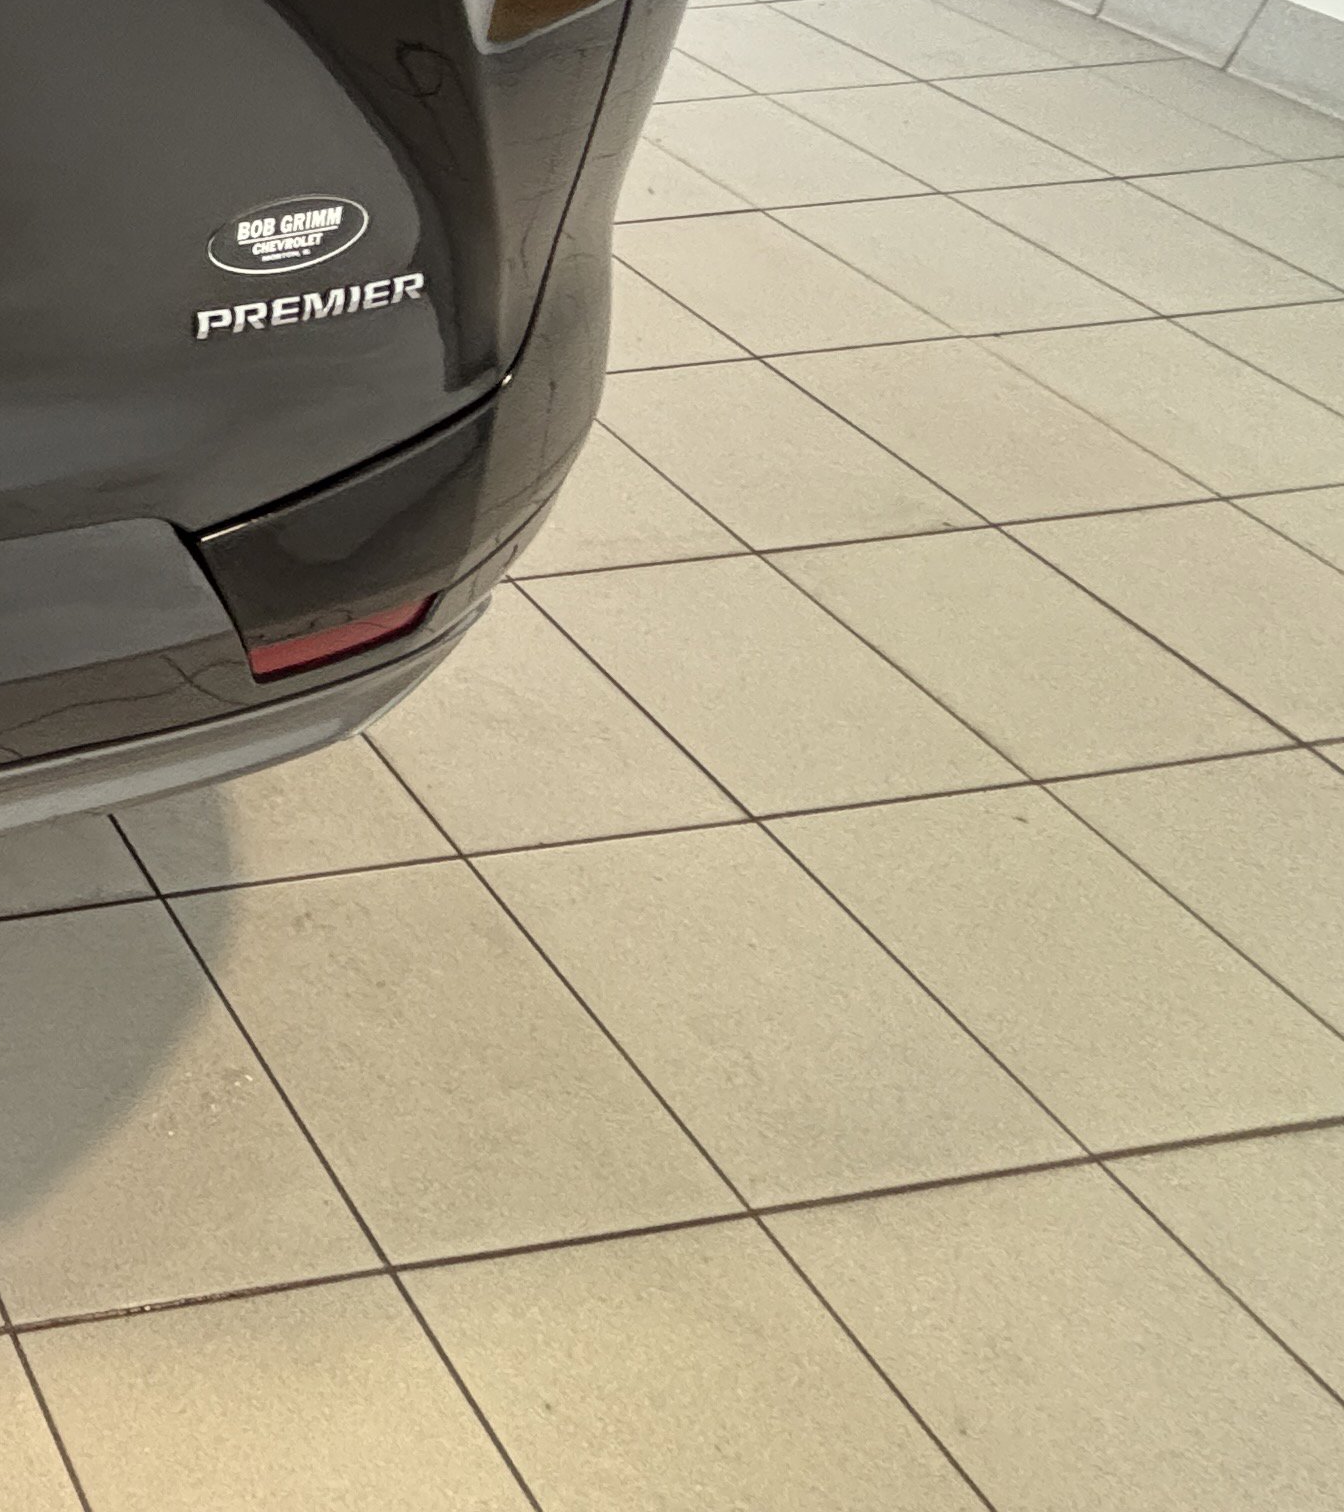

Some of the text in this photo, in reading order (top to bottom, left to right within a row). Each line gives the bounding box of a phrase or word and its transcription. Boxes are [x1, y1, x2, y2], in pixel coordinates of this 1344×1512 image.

[236, 206, 344, 241] BOB GRIMM
[252, 232, 324, 255] CHEVROLET
[194, 271, 426, 341] PREMIER
